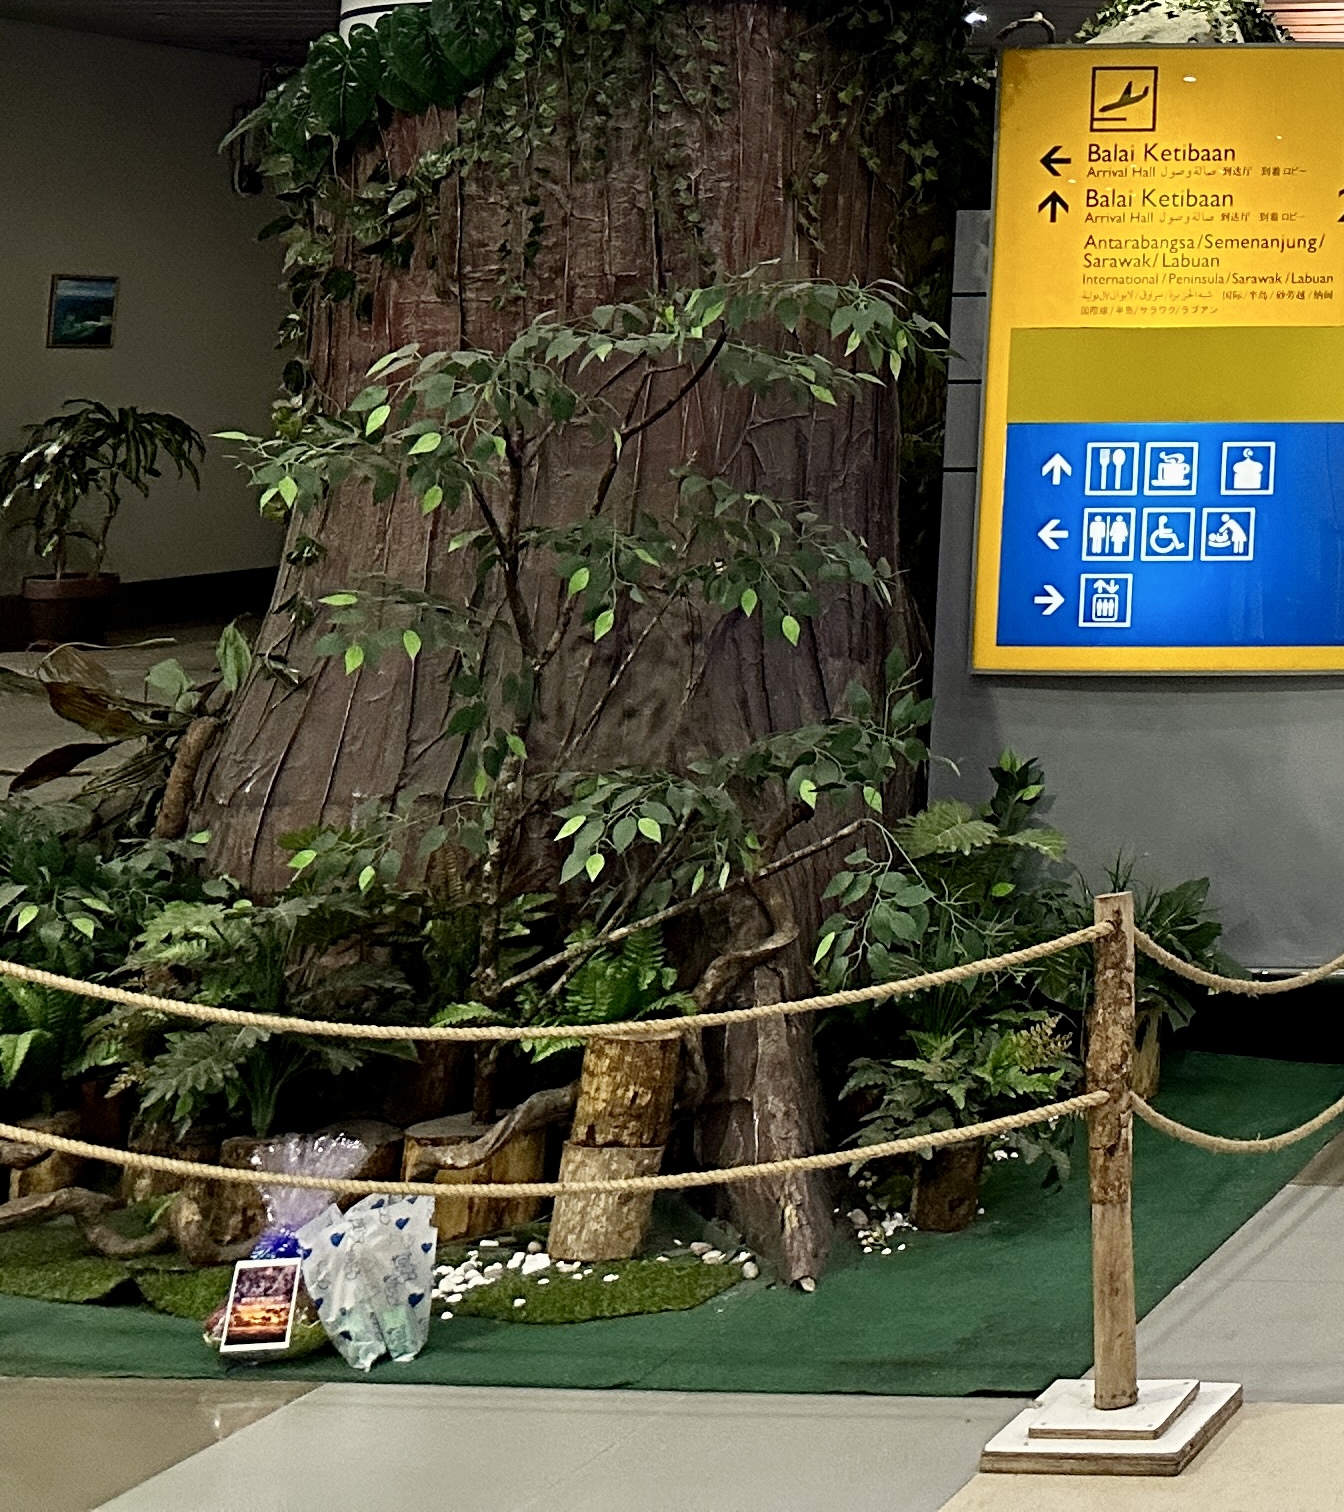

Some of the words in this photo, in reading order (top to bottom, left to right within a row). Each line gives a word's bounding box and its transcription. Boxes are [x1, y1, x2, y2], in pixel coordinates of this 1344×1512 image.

[1087, 143, 1136, 163] Balai
[1143, 143, 1237, 163] Ketibaan
[1086, 166, 1128, 178] Arrival
[1131, 166, 1156, 178] Hall
[1085, 188, 1134, 208] Balai
[1141, 188, 1235, 208] Ketibaan
[1084, 212, 1127, 224] Arrival
[1129, 212, 1154, 224] Hall
[1161, 253, 1221, 269] Labuan
